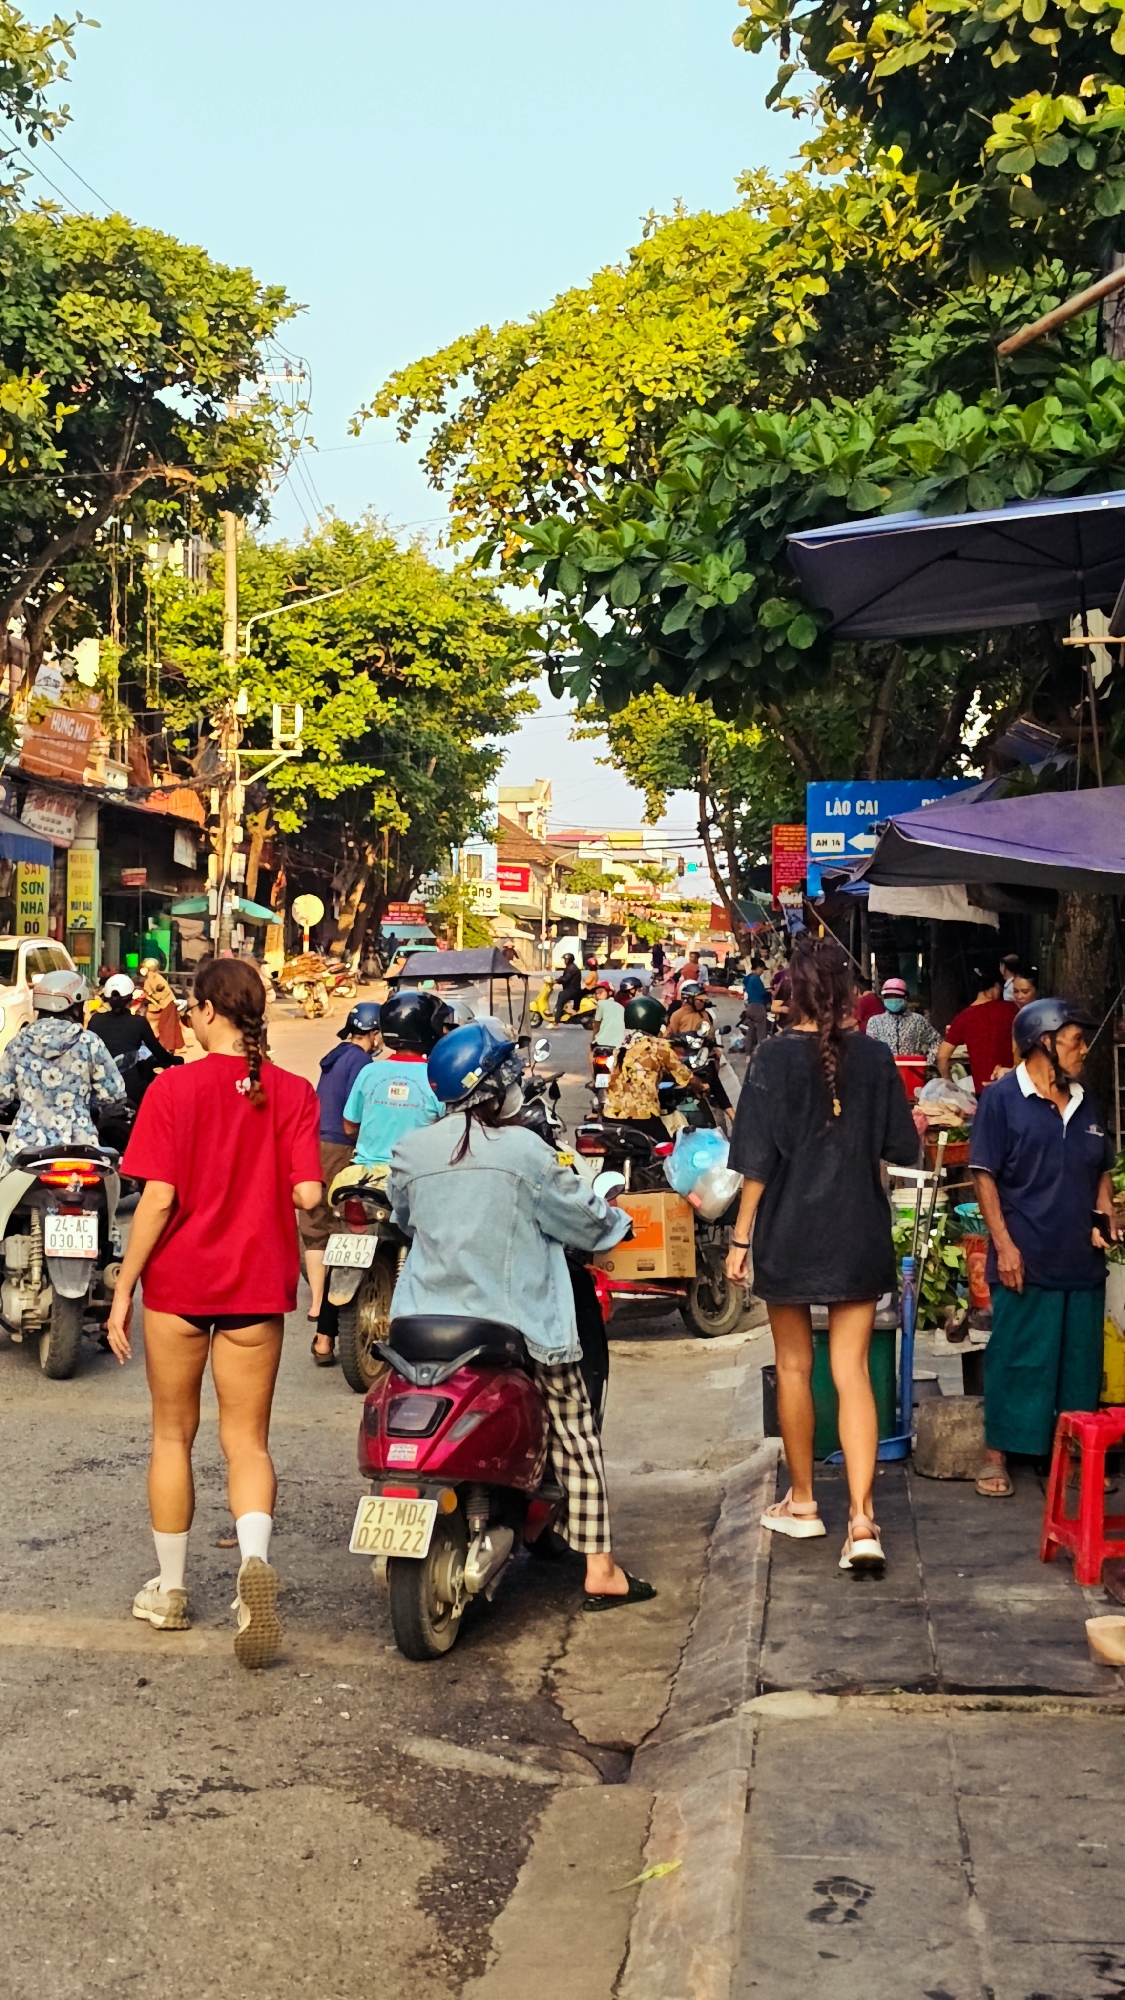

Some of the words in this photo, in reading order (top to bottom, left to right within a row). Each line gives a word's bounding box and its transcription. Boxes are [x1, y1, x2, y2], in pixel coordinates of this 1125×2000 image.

[825, 797, 852, 817] LÀO
[855, 799, 879, 816] CAI
[815, 839, 828, 847] AH
[831, 839, 841, 847] 14
[20, 881, 45, 895] SƠN
[20, 898, 44, 915] NHÀ
[55, 1218, 89, 1233] 24-AC
[50, 1233, 94, 1249] 030.13
[334, 1236, 369, 1251] 24-Y1
[357, 1526, 425, 1553] 020.22
